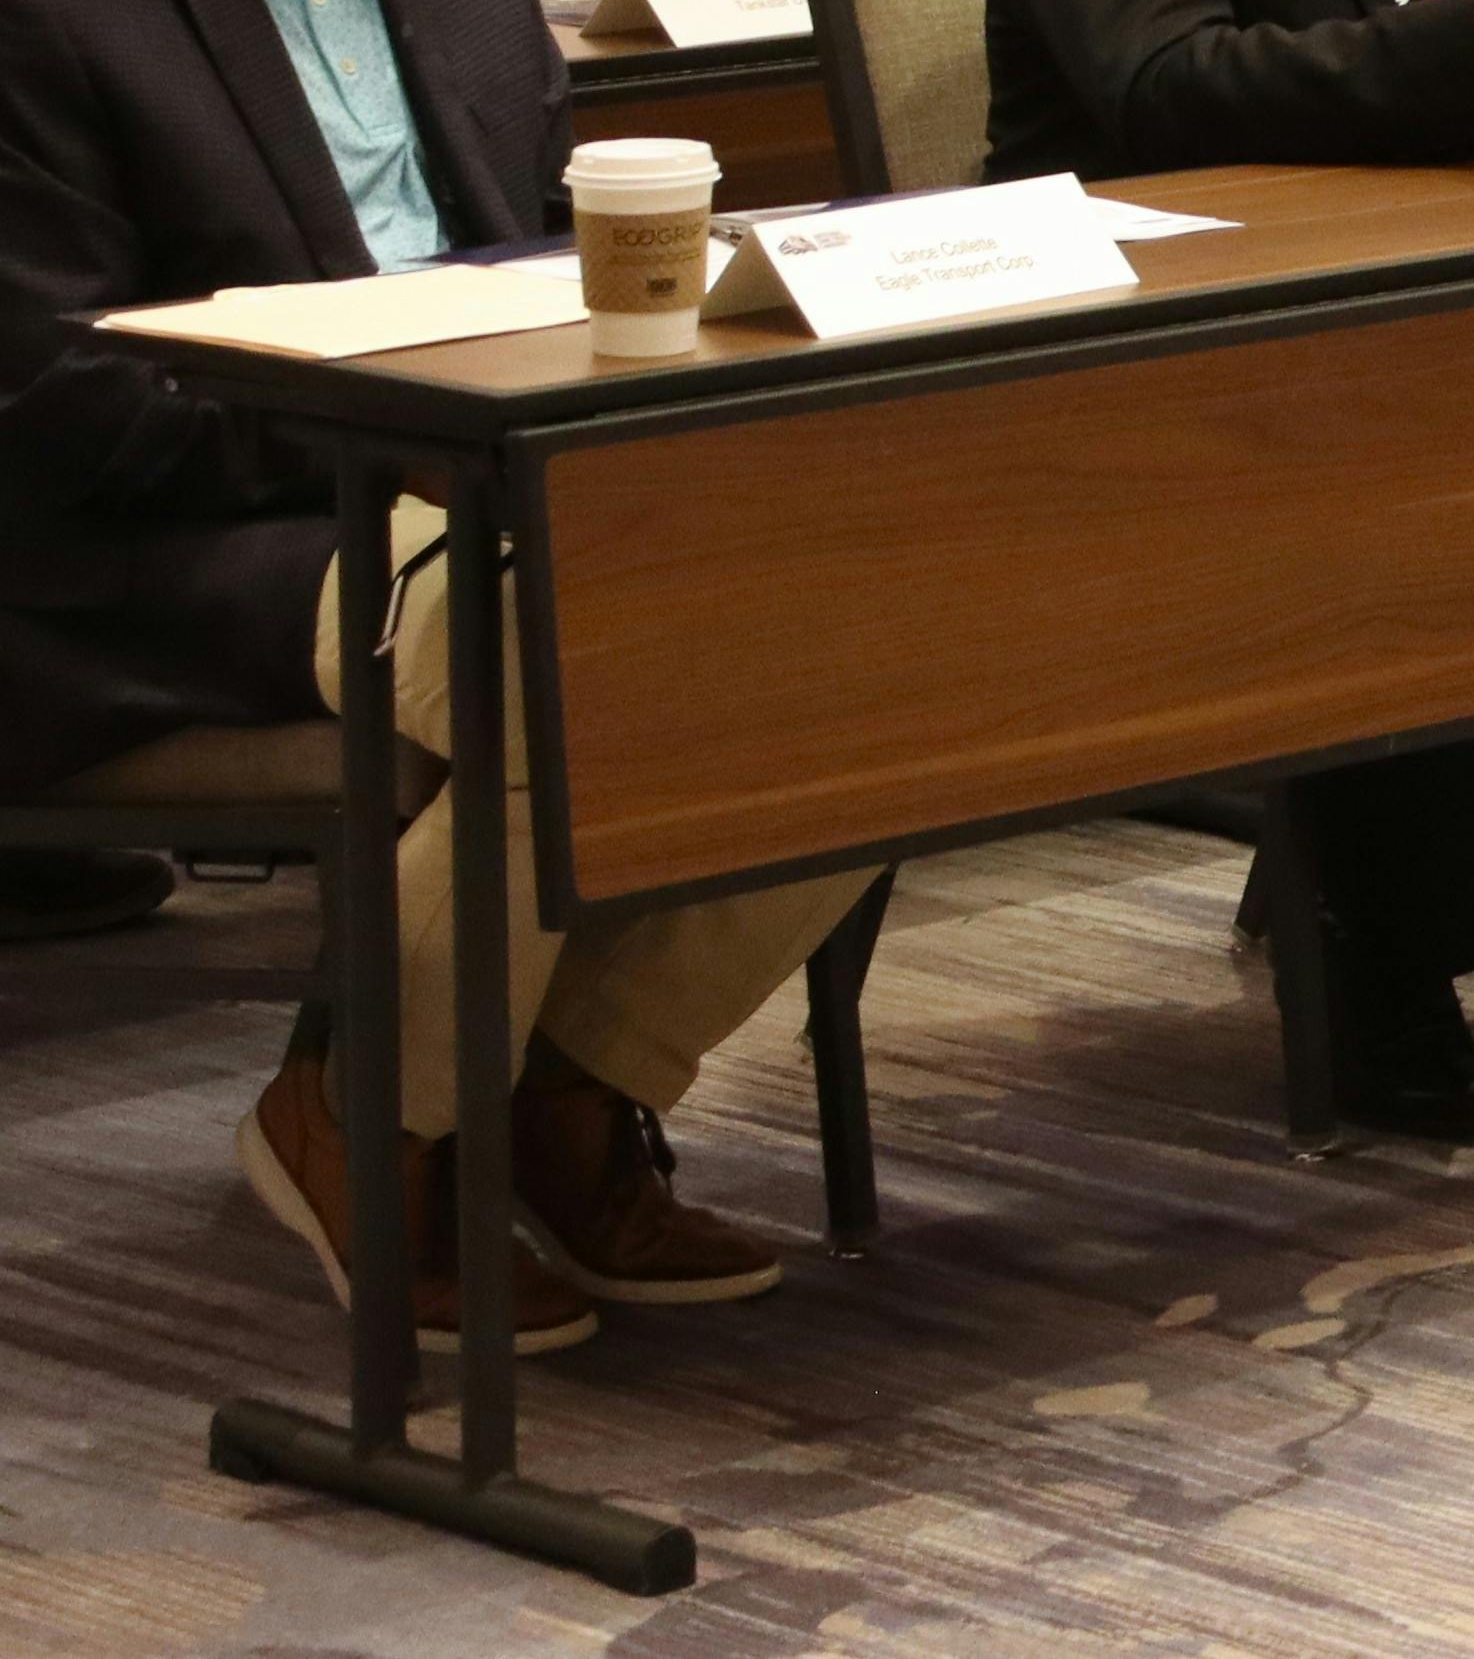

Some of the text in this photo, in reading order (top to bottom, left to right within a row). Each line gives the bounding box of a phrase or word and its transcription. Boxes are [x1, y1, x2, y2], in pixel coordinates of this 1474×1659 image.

[889, 236, 1000, 265] Lance Collette
[875, 273, 922, 291] Eagle
[922, 261, 994, 282] Transport
